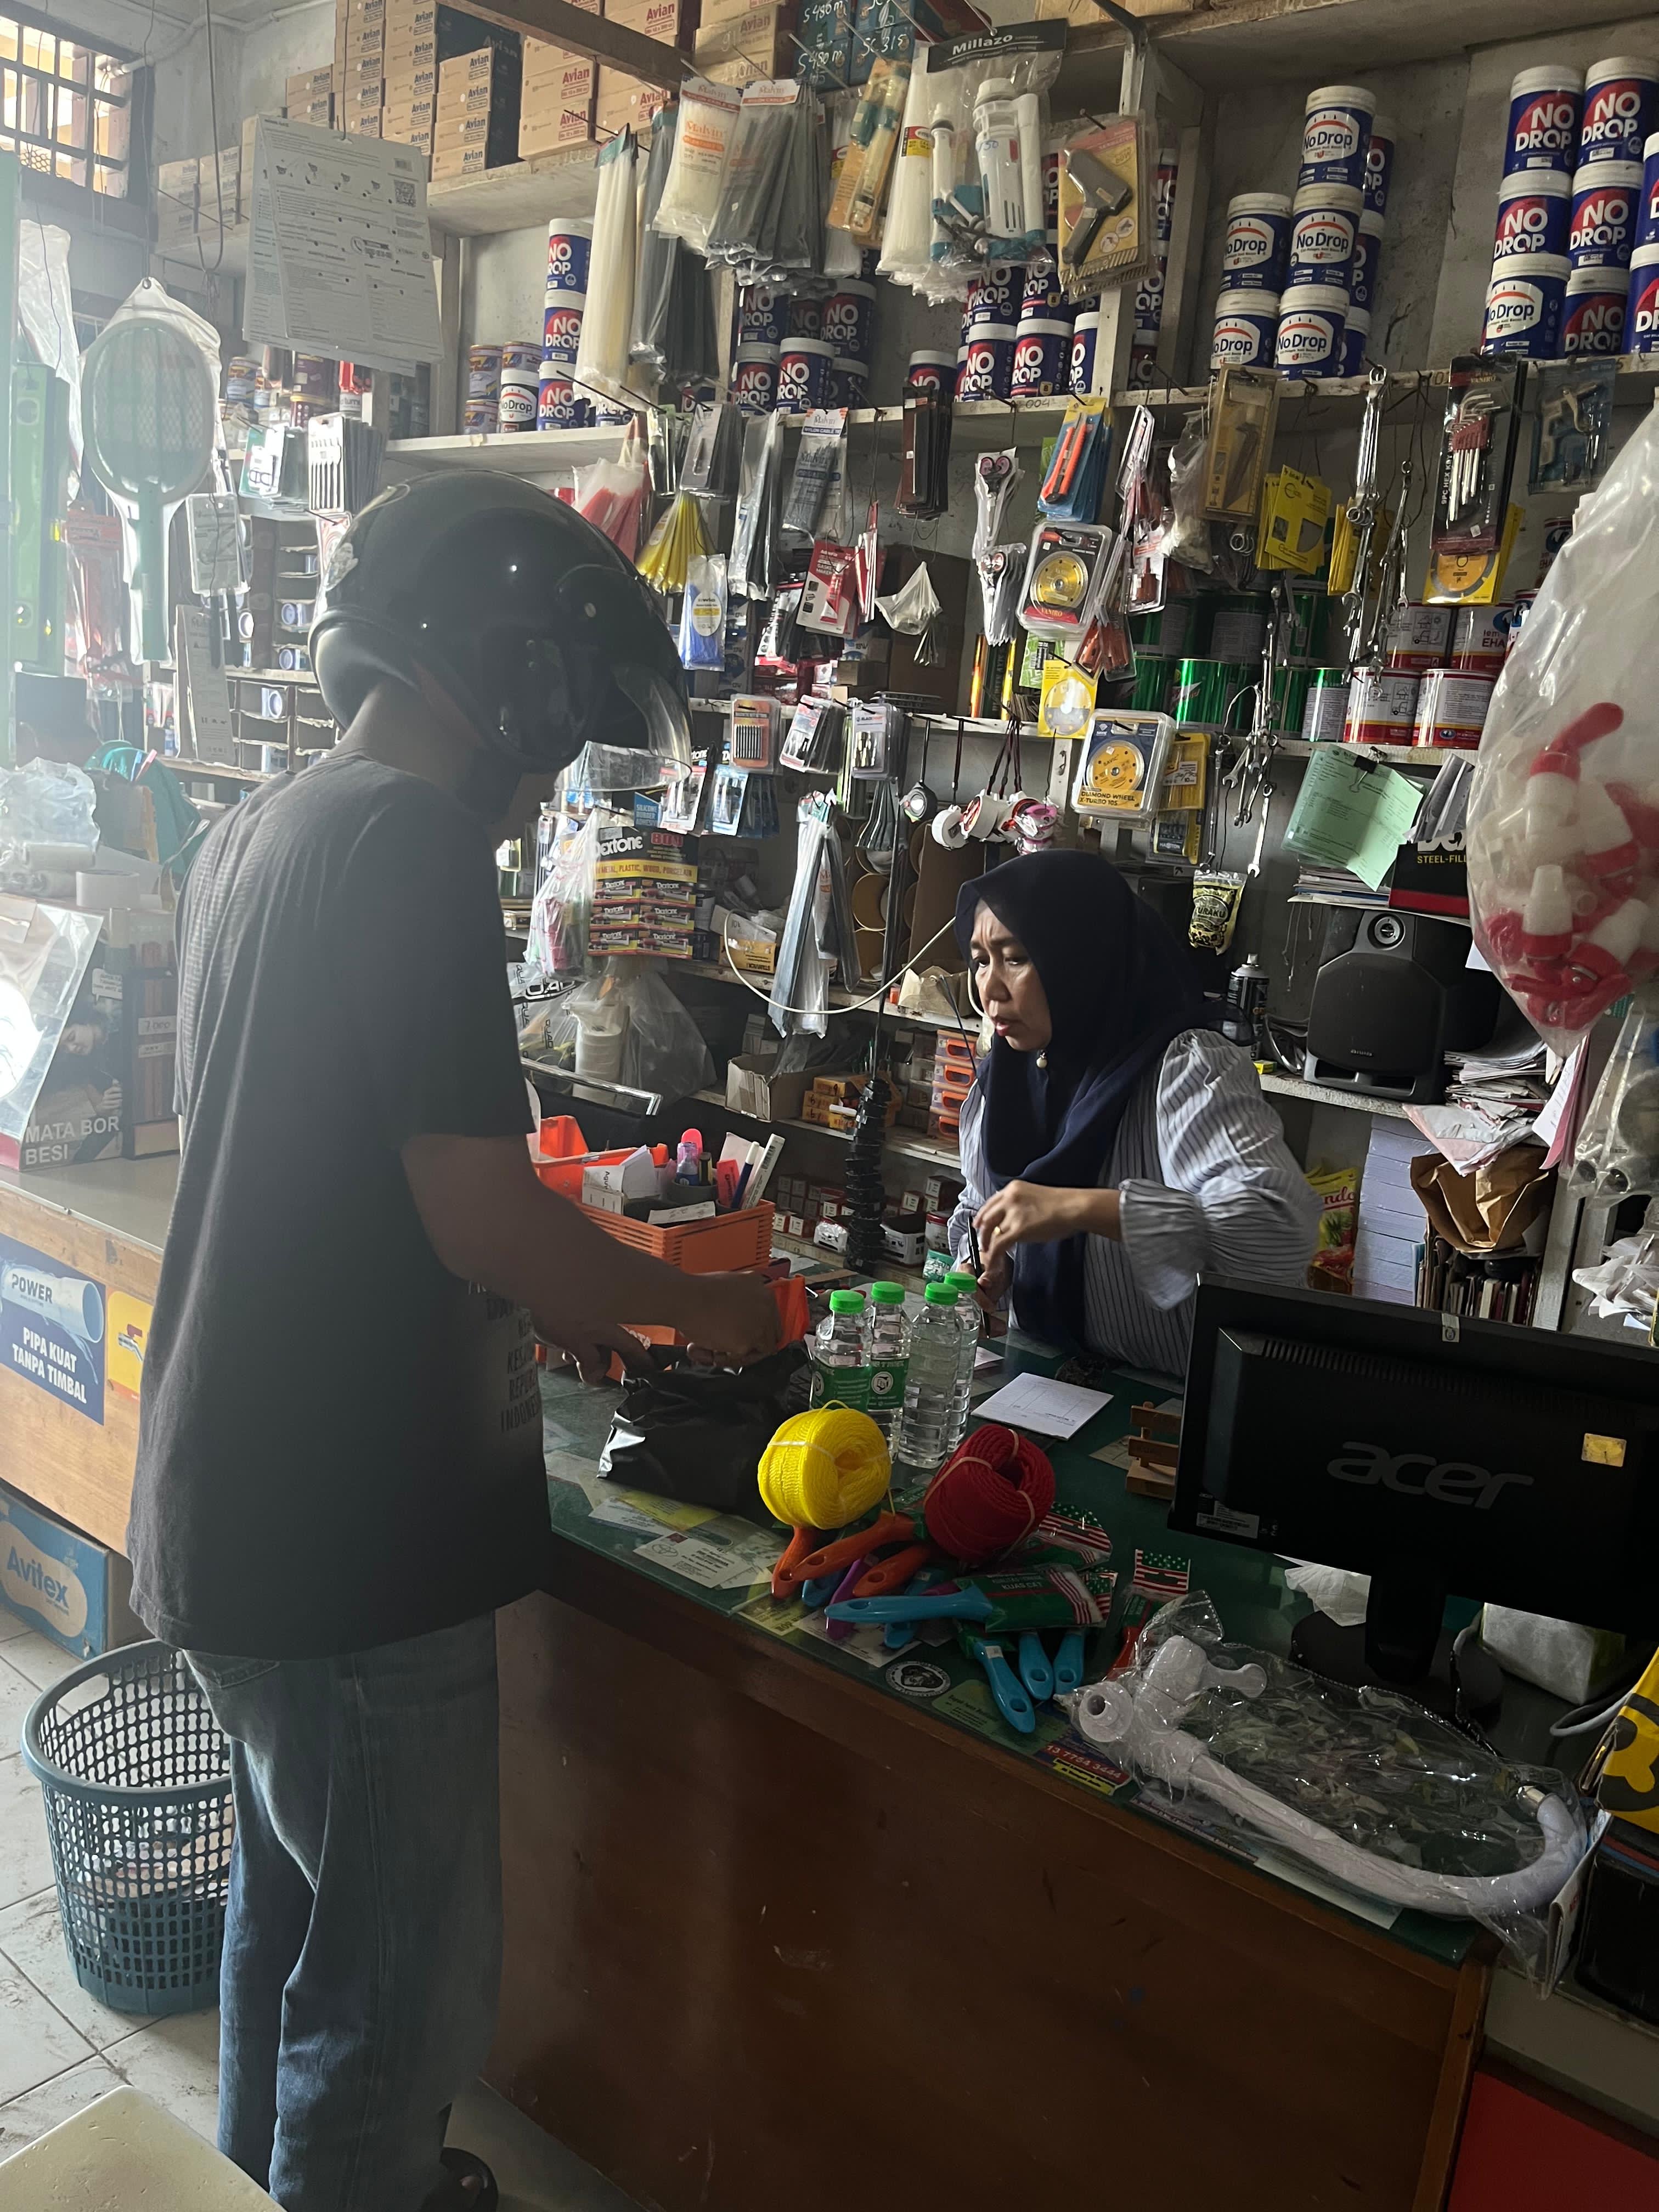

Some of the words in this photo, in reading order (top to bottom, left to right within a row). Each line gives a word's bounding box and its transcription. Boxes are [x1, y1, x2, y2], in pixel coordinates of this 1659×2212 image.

[415, 11, 433, 24] Avian
[646, 4, 674, 21] Avian
[741, 15, 771, 32] Avian
[362, 29, 380, 42] Avian
[952, 34, 1013, 55] Millazo
[414, 42, 433, 54] Avian
[362, 57, 380, 70] Avian
[470, 55, 489, 67] Avian
[414, 71, 433, 83] Avian
[562, 67, 590, 84] Avian
[361, 85, 379, 98] Avian
[468, 86, 488, 99] Avian
[640, 90, 668, 106] Avian
[412, 101, 430, 114] Avian
[1594, 91, 1641, 122] NO
[360, 115, 378, 128] Avian
[466, 118, 486, 131] Avian
[560, 109, 586, 126] Avian
[1531, 103, 1575, 130] NO
[411, 132, 429, 143] Avian
[1304, 134, 1316, 150] No
[1317, 131, 1353, 149] Drop
[1515, 129, 1572, 152] DROP
[1581, 118, 1638, 146] DROP
[464, 150, 483, 163] Avian
[1504, 206, 1548, 236] NO
[1583, 199, 1629, 227] NO
[1233, 239, 1267, 256] Drop
[1296, 233, 1314, 250] No
[1316, 232, 1348, 252] Drop
[1493, 233, 1545, 259] DROP
[1570, 225, 1627, 251] DROP
[549, 243, 572, 262] NO
[549, 261, 571, 275] ROP
[979, 267, 1012, 287] NO
[1023, 279, 1049, 298] ROP
[744, 292, 775, 312] NO
[827, 303, 859, 325] NO
[1496, 304, 1534, 321] Drop
[1582, 304, 1624, 335] NO
[553, 317, 582, 336] NO
[545, 334, 580, 349] DROP
[1220, 338, 1253, 354] Drop
[1277, 334, 1291, 351] No
[1292, 332, 1327, 352] Drop
[1565, 330, 1621, 353] DROP
[966, 351, 995, 376] NO
[1015, 345, 1043, 369] NO
[741, 371, 772, 391] NO
[780, 362, 810, 385] NO
[1012, 367, 1042, 386] ROP
[777, 384, 808, 400] ROP
[965, 374, 993, 393] ROP
[546, 387, 575, 407] NO
[508, 399, 533, 415] Drop
[539, 406, 575, 421] DROP
[1442, 473, 1451, 489] HEX
[1041, 607, 1063, 617] VANIRO
[1079, 797, 1107, 805] X-TURBO
[1081, 791, 1111, 799] DIAMOND
[1112, 793, 1135, 802] WHEEL
[619, 864, 641, 873] PLASTIC,
[26, 1120, 75, 1144] MATA
[80, 1115, 120, 1137] BOR
[25, 1143, 69, 1166] BESI
[11, 1273, 54, 1305] POWER
[22, 1326, 48, 1356] PIPA
[48, 1341, 78, 1374] KUAT
[12, 1342, 46, 1380] TANPA
[47, 1363, 88, 1405] TIMBAL
[1327, 1441, 1535, 1510] acer
[7, 1554, 68, 1605] Avitex
